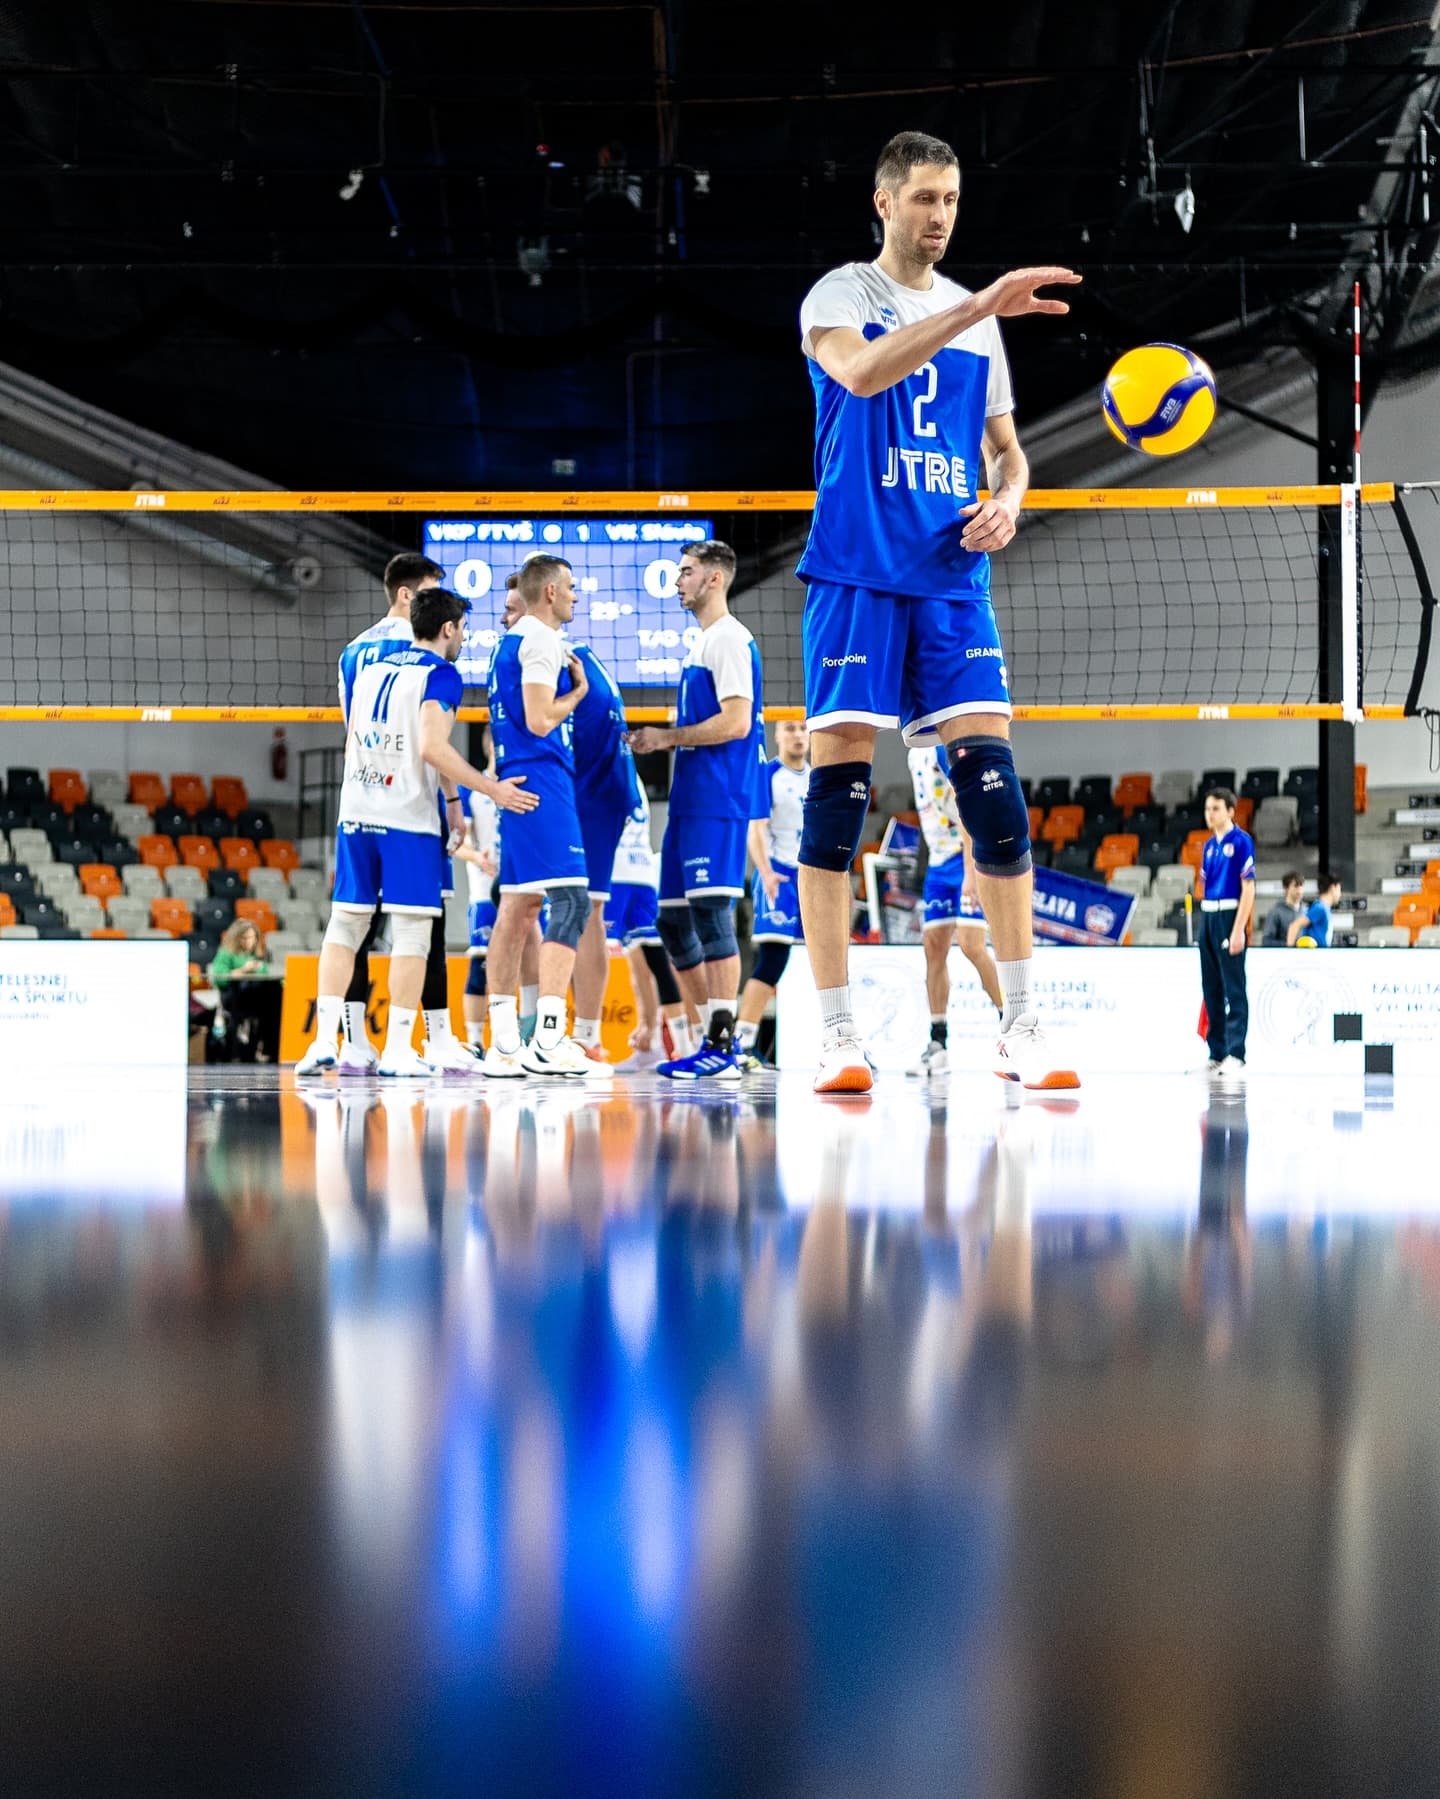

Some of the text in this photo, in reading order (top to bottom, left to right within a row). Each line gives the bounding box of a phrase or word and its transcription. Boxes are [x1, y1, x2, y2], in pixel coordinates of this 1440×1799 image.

[913, 361, 938, 438] 2
[881, 447, 971, 499] JTRE
[453, 558, 493, 599] 0
[642, 558, 681, 599] 0
[371, 671, 399, 724] 11
